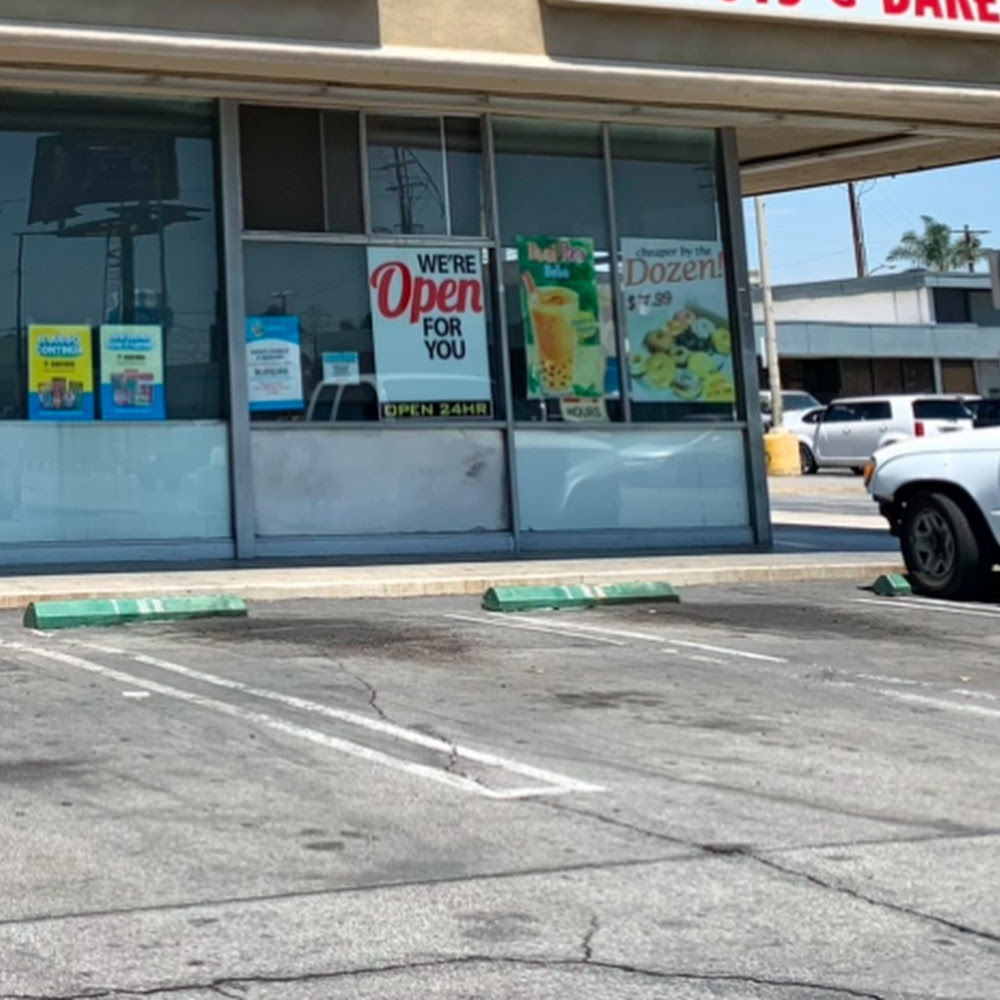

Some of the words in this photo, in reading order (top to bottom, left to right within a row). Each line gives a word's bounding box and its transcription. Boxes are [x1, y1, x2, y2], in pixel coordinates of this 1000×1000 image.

[635, 247, 677, 259] cheaper
[680, 245, 694, 258] by
[695, 245, 712, 256] the
[417, 253, 477, 274] WE'RE
[624, 251, 725, 287] Dozen!
[370, 261, 484, 325] Open
[422, 317, 462, 338] FOR
[424, 339, 466, 360] YOU
[384, 404, 434, 416] OPEN
[438, 403, 488, 416] 24HR
